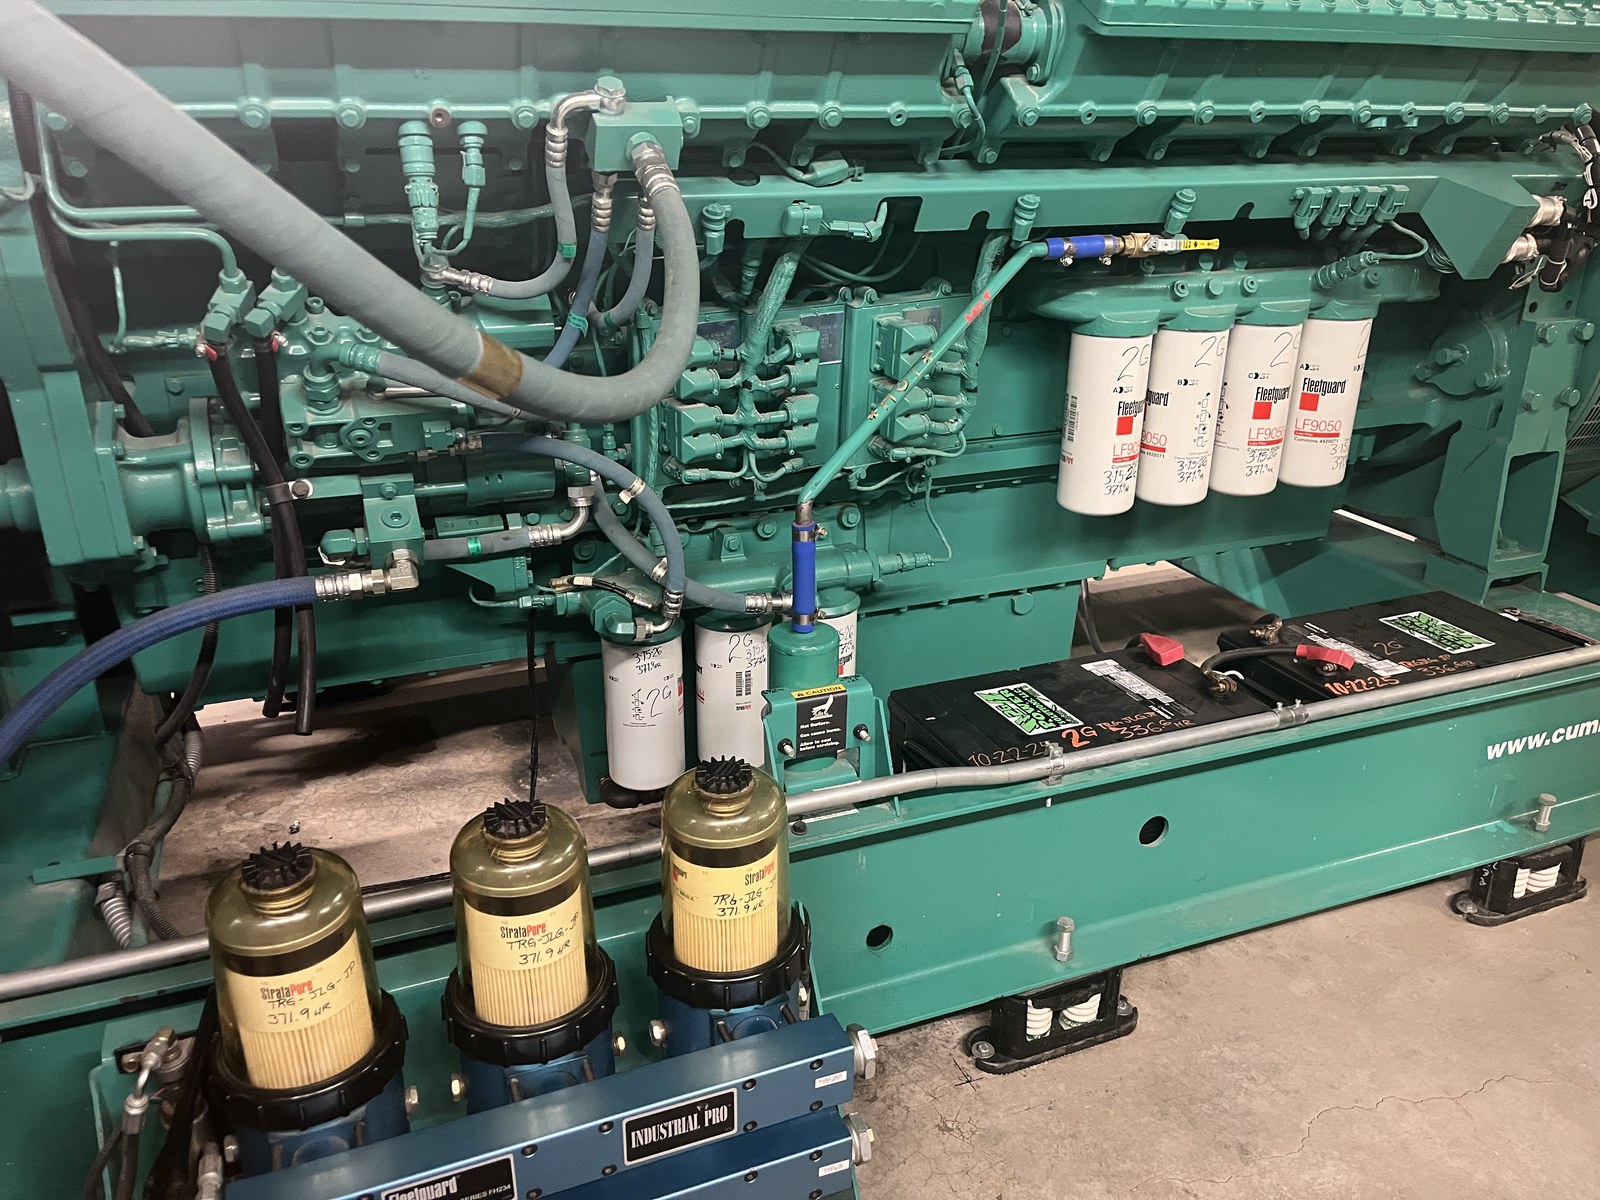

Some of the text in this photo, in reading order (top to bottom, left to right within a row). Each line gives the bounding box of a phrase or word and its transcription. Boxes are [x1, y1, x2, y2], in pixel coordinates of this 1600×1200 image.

[1194, 335, 1225, 368] 2G
[1117, 344, 1150, 381] 2G
[1302, 377, 1347, 396] Fleetguard
[1294, 417, 1342, 432] LF9050
[728, 632, 753, 664] 2G
[1373, 640, 1404, 656] 2G
[805, 685, 842, 694] CAUTION
[646, 685, 672, 718] 2G
[999, 689, 1057, 729] POWER
[1061, 726, 1098, 748] 2G
[1487, 719, 1600, 760] www.cum
[500, 922, 547, 939] StrataPore
[260, 980, 314, 1000] StrataPore
[268, 1008, 310, 1025] 371.9
[630, 1104, 729, 1149] INDUSTRIAL PRO
[488, 1183, 511, 1195] FH234
